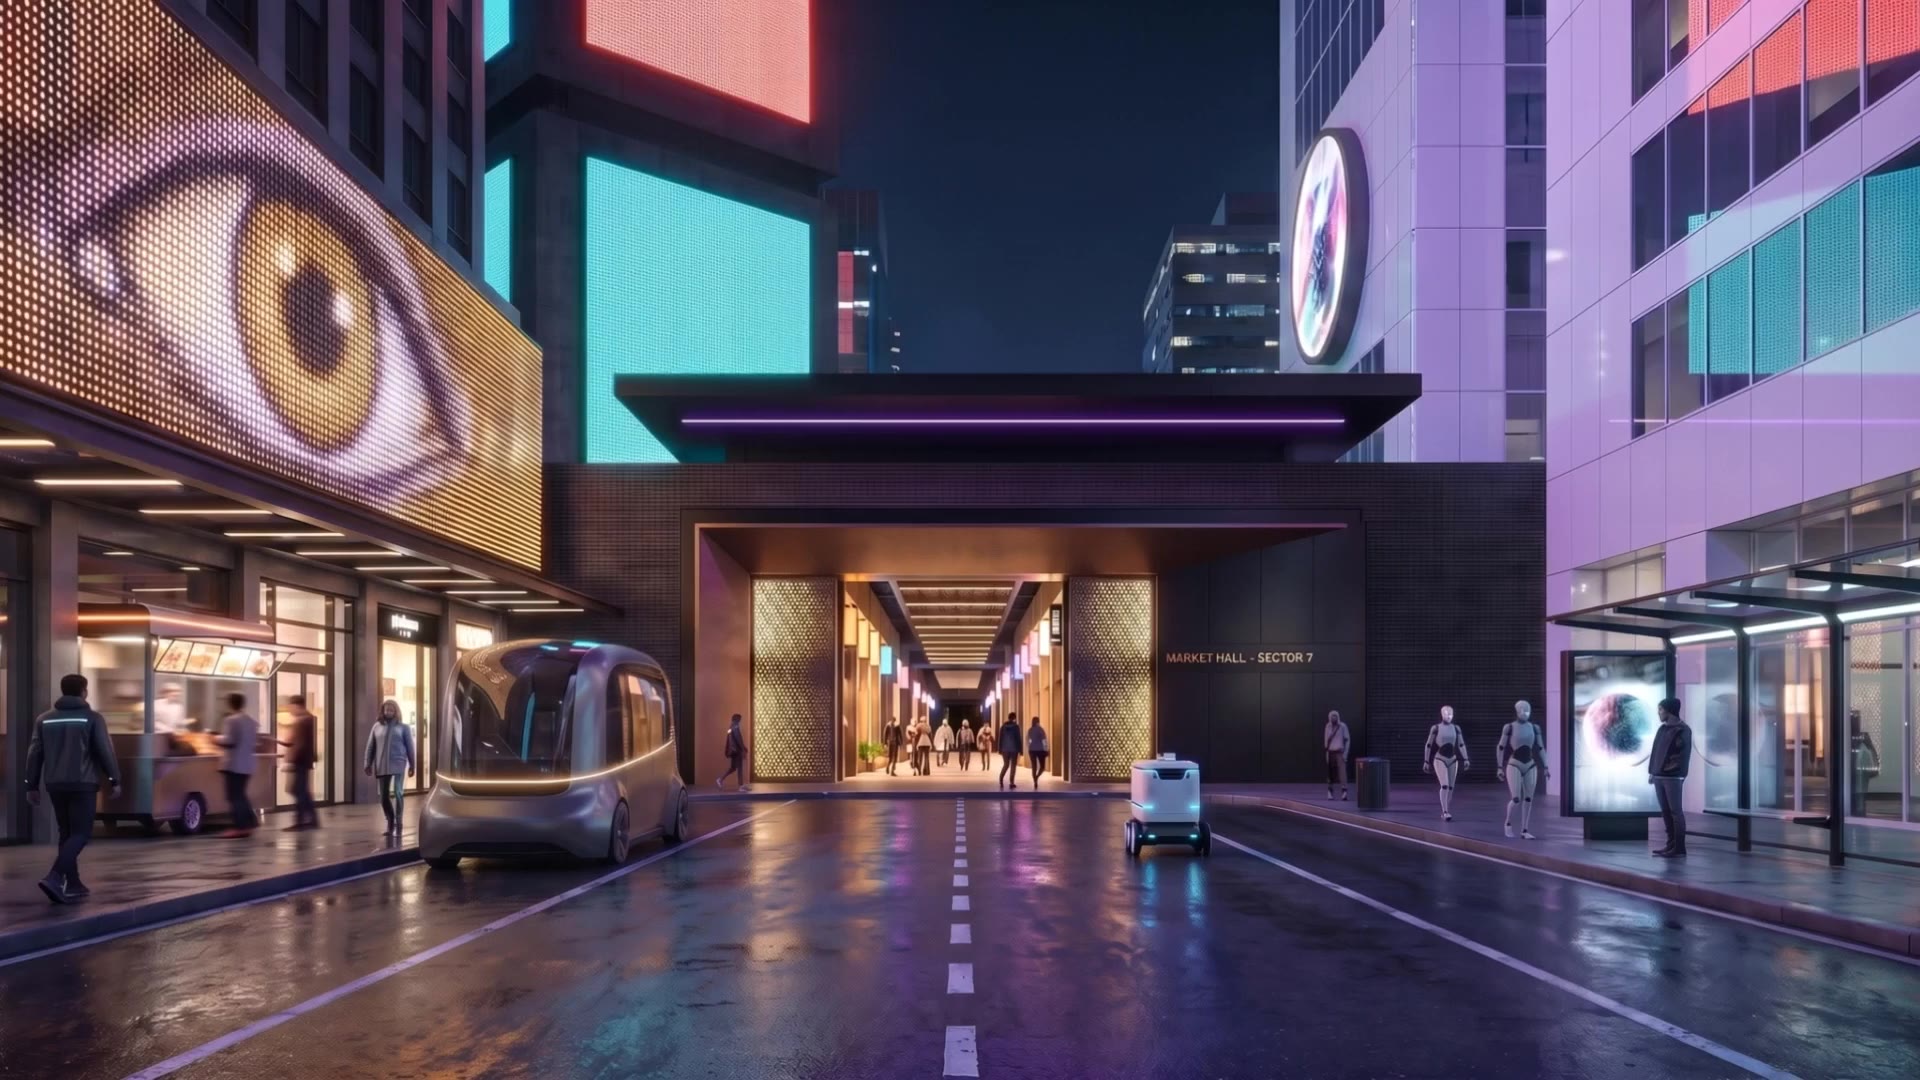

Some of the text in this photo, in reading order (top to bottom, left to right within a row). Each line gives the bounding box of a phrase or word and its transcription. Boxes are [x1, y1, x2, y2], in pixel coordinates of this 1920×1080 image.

[1166, 652, 1214, 663] MARKET
[1216, 652, 1246, 663] HALL
[1258, 652, 1303, 663] SECTOR
[1306, 652, 1313, 663] 7
